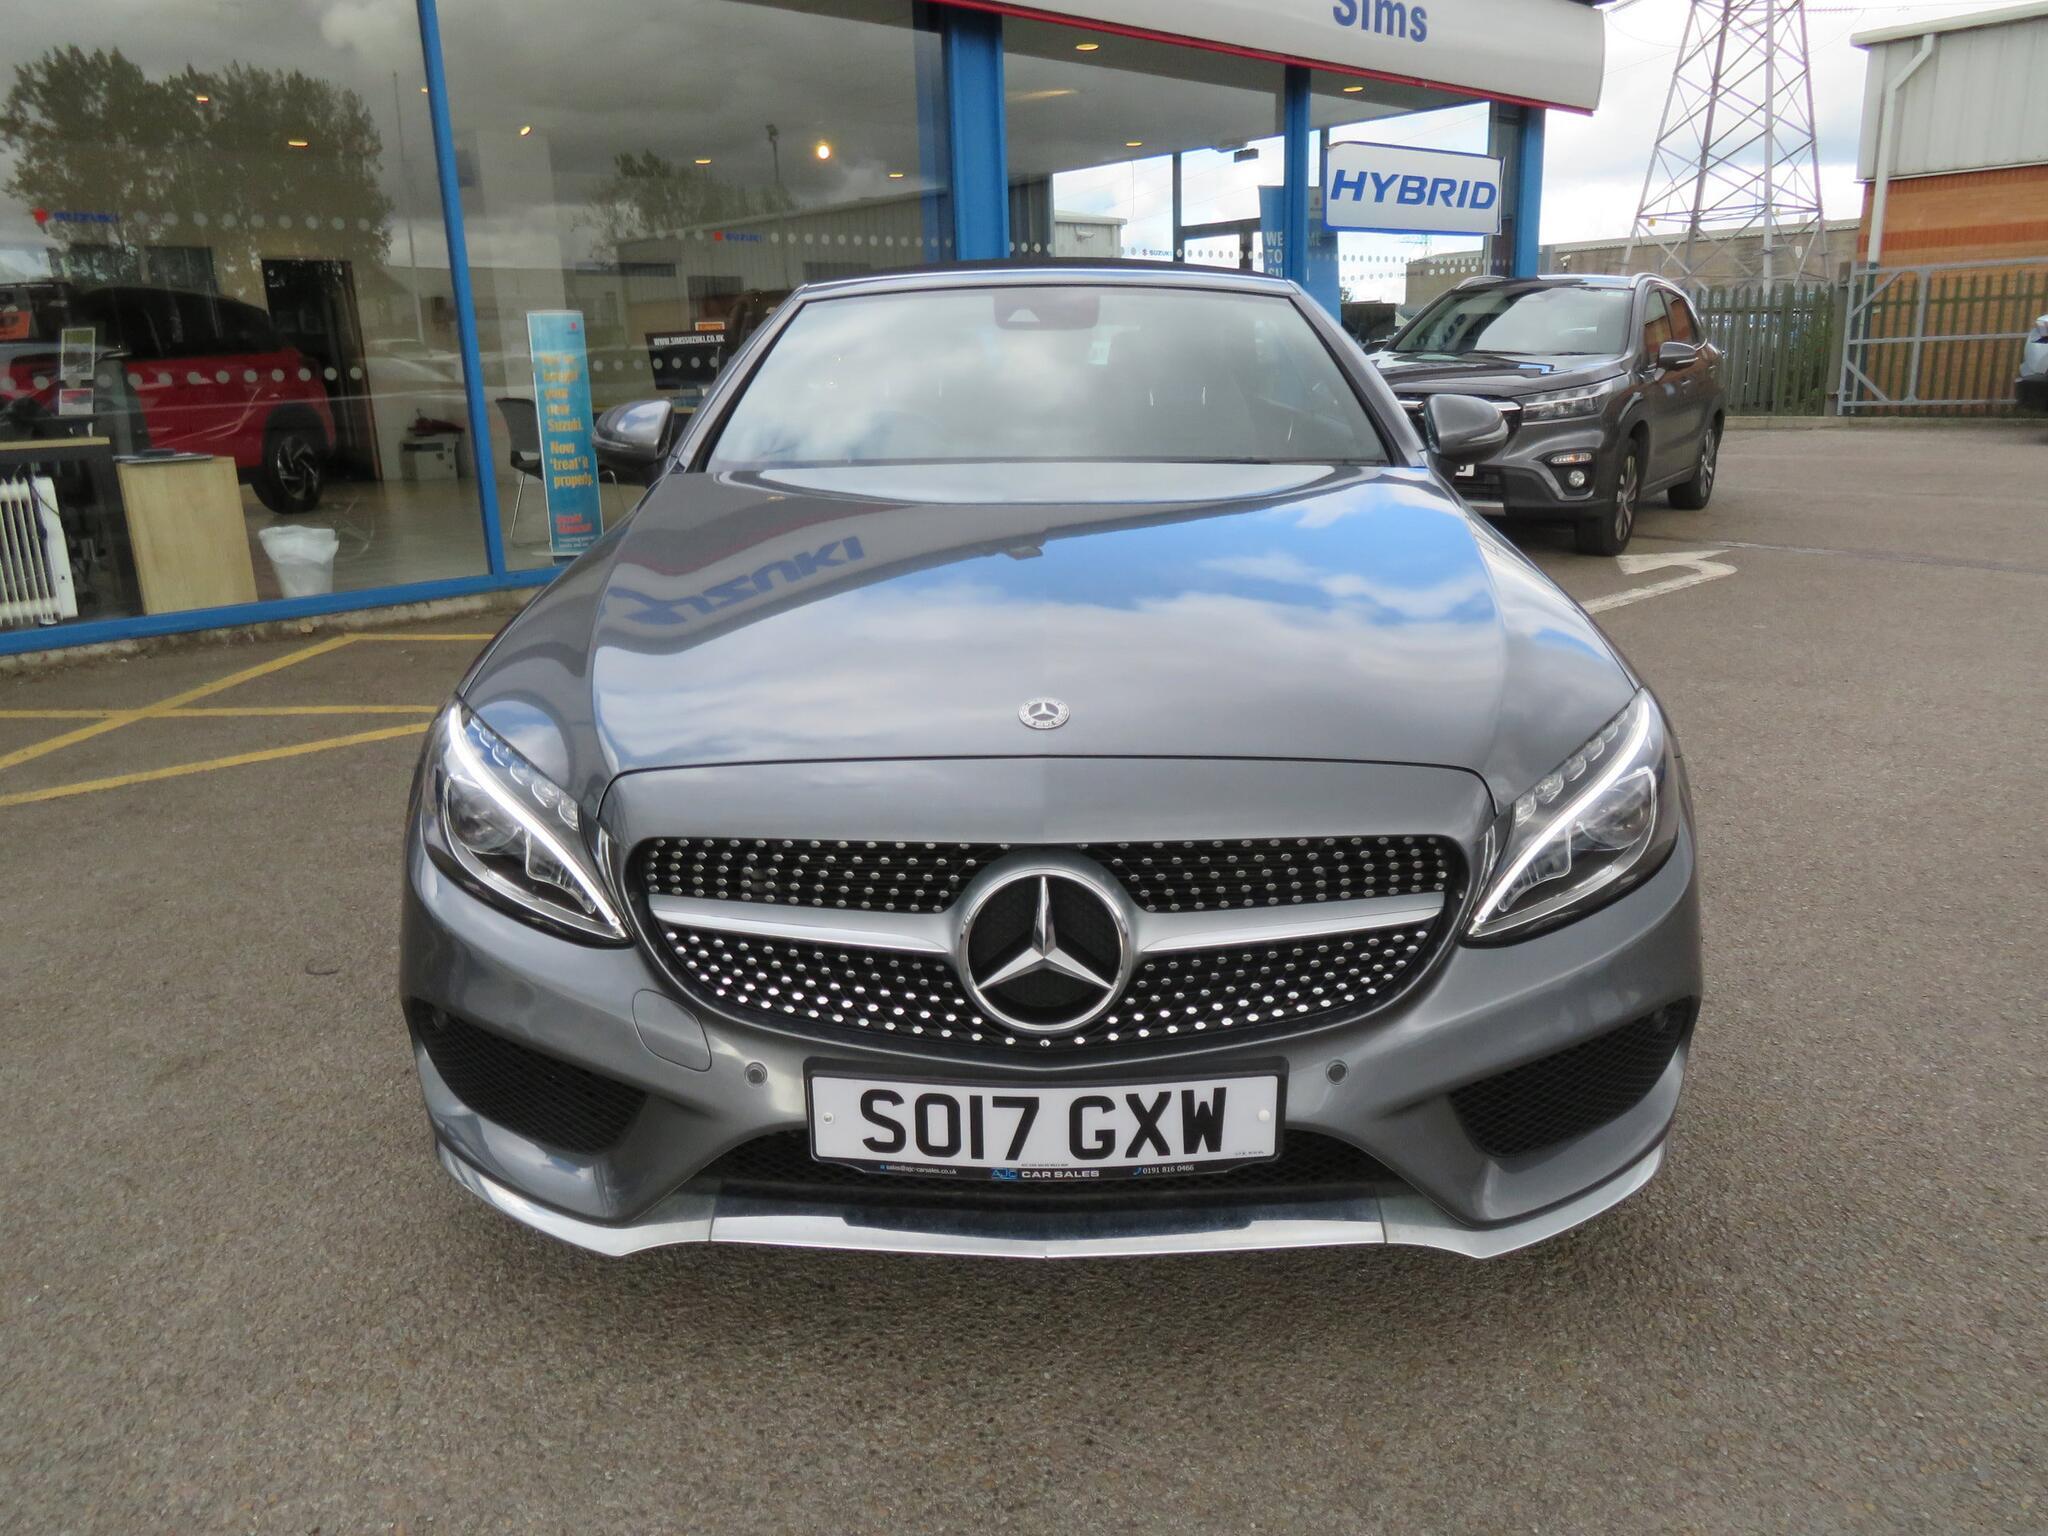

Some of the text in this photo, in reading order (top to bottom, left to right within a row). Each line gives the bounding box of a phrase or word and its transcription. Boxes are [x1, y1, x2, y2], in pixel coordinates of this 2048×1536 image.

[1333, 0, 1427, 42] Sims
[1330, 169, 1497, 210] HYBRID
[550, 440, 576, 454] Now
[860, 1087, 1228, 1161] SO17 GXW
[886, 1164, 957, 1175] sales@ajc-carsales.co.uk
[1021, 1170, 1052, 1179] CAR
[1054, 1169, 1101, 1179] SALES
[1142, 1164, 1195, 1175] 0191 816 0466
